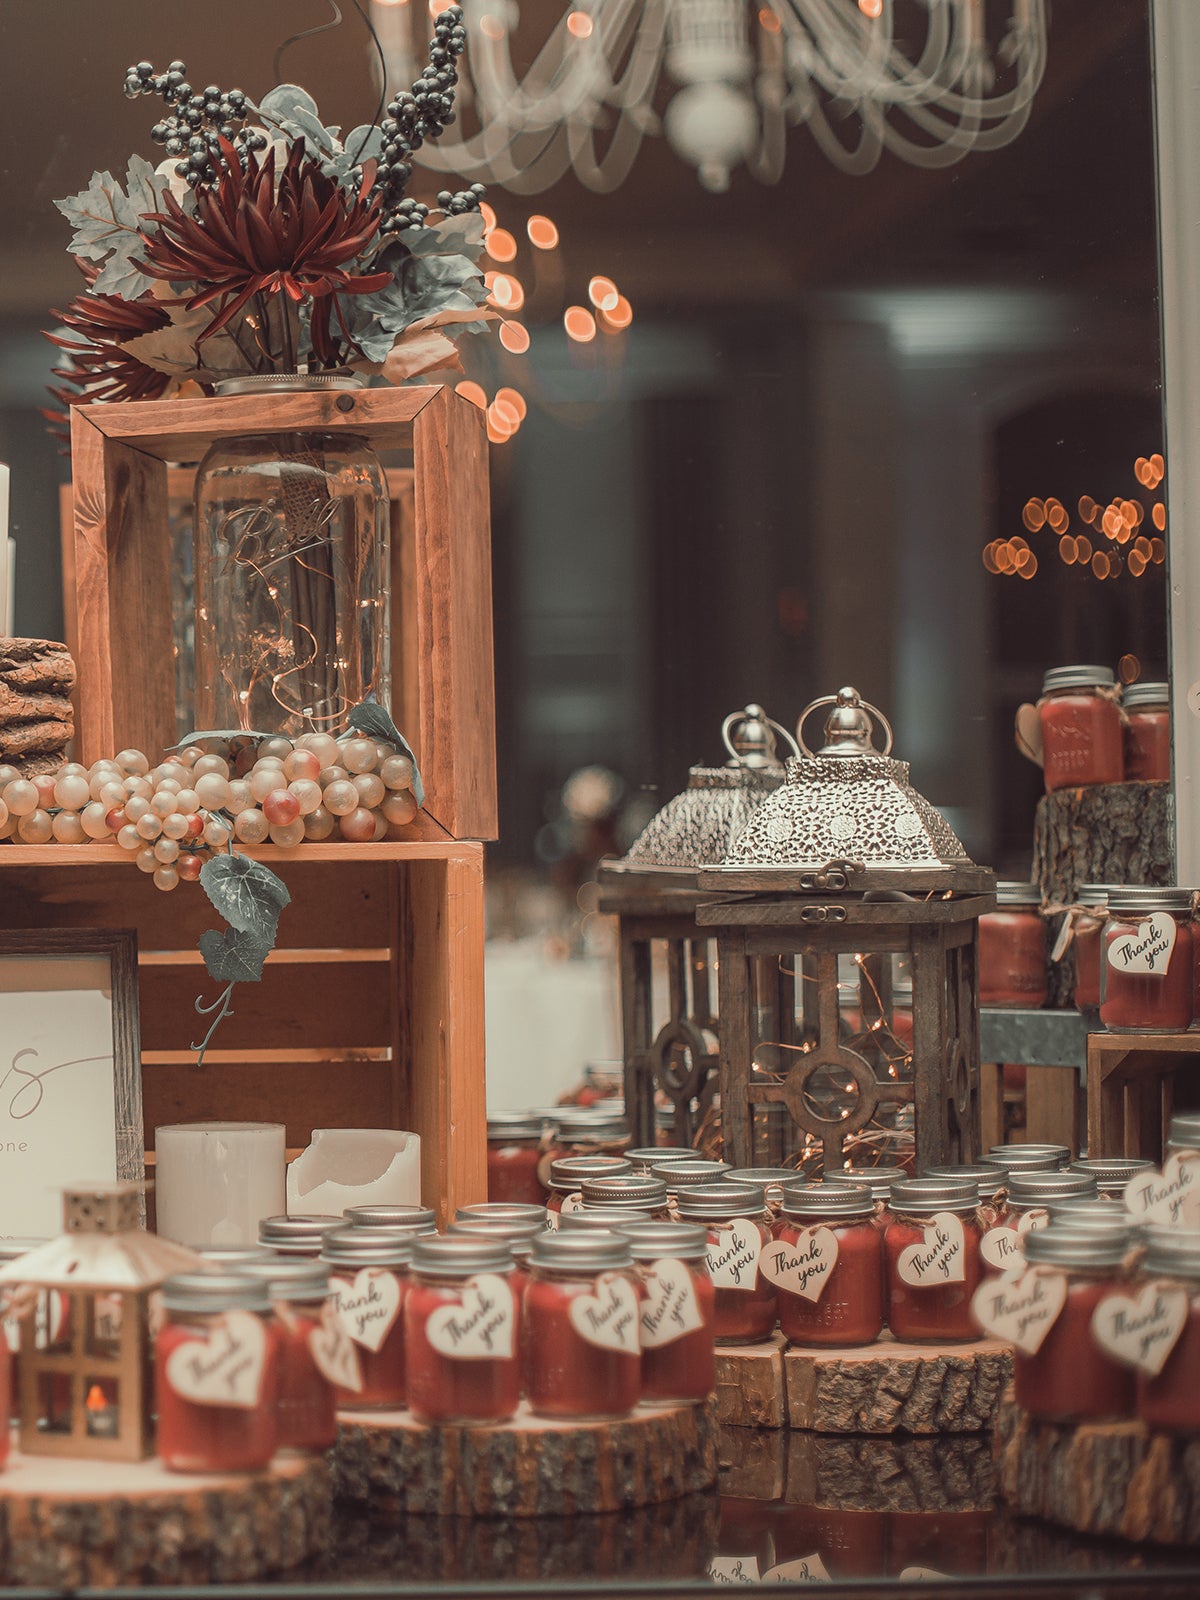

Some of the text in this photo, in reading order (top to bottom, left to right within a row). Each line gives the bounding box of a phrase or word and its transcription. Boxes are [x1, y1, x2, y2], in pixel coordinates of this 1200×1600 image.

[1117, 925, 1162, 966] Thank
[1145, 939, 1169, 970] you
[1136, 1164, 1193, 1212] Thank
[705, 1233, 746, 1272] hank
[729, 1250, 754, 1284] you
[770, 1239, 822, 1276] Thank
[908, 1228, 949, 1278] Thank
[938, 1241, 959, 1278] you
[798, 1262, 827, 1290] you
[441, 1291, 495, 1347] Thank
[585, 1288, 624, 1332] Thank
[641, 1279, 675, 1336] Thank
[670, 1288, 688, 1328] you
[991, 1280, 1043, 1321] Thank
[1112, 1296, 1167, 1339] Thank
[356, 1308, 387, 1335] you
[479, 1310, 506, 1350] you
[612, 1311, 633, 1344] you
[1018, 1309, 1049, 1340] you
[1140, 1326, 1171, 1359] you
